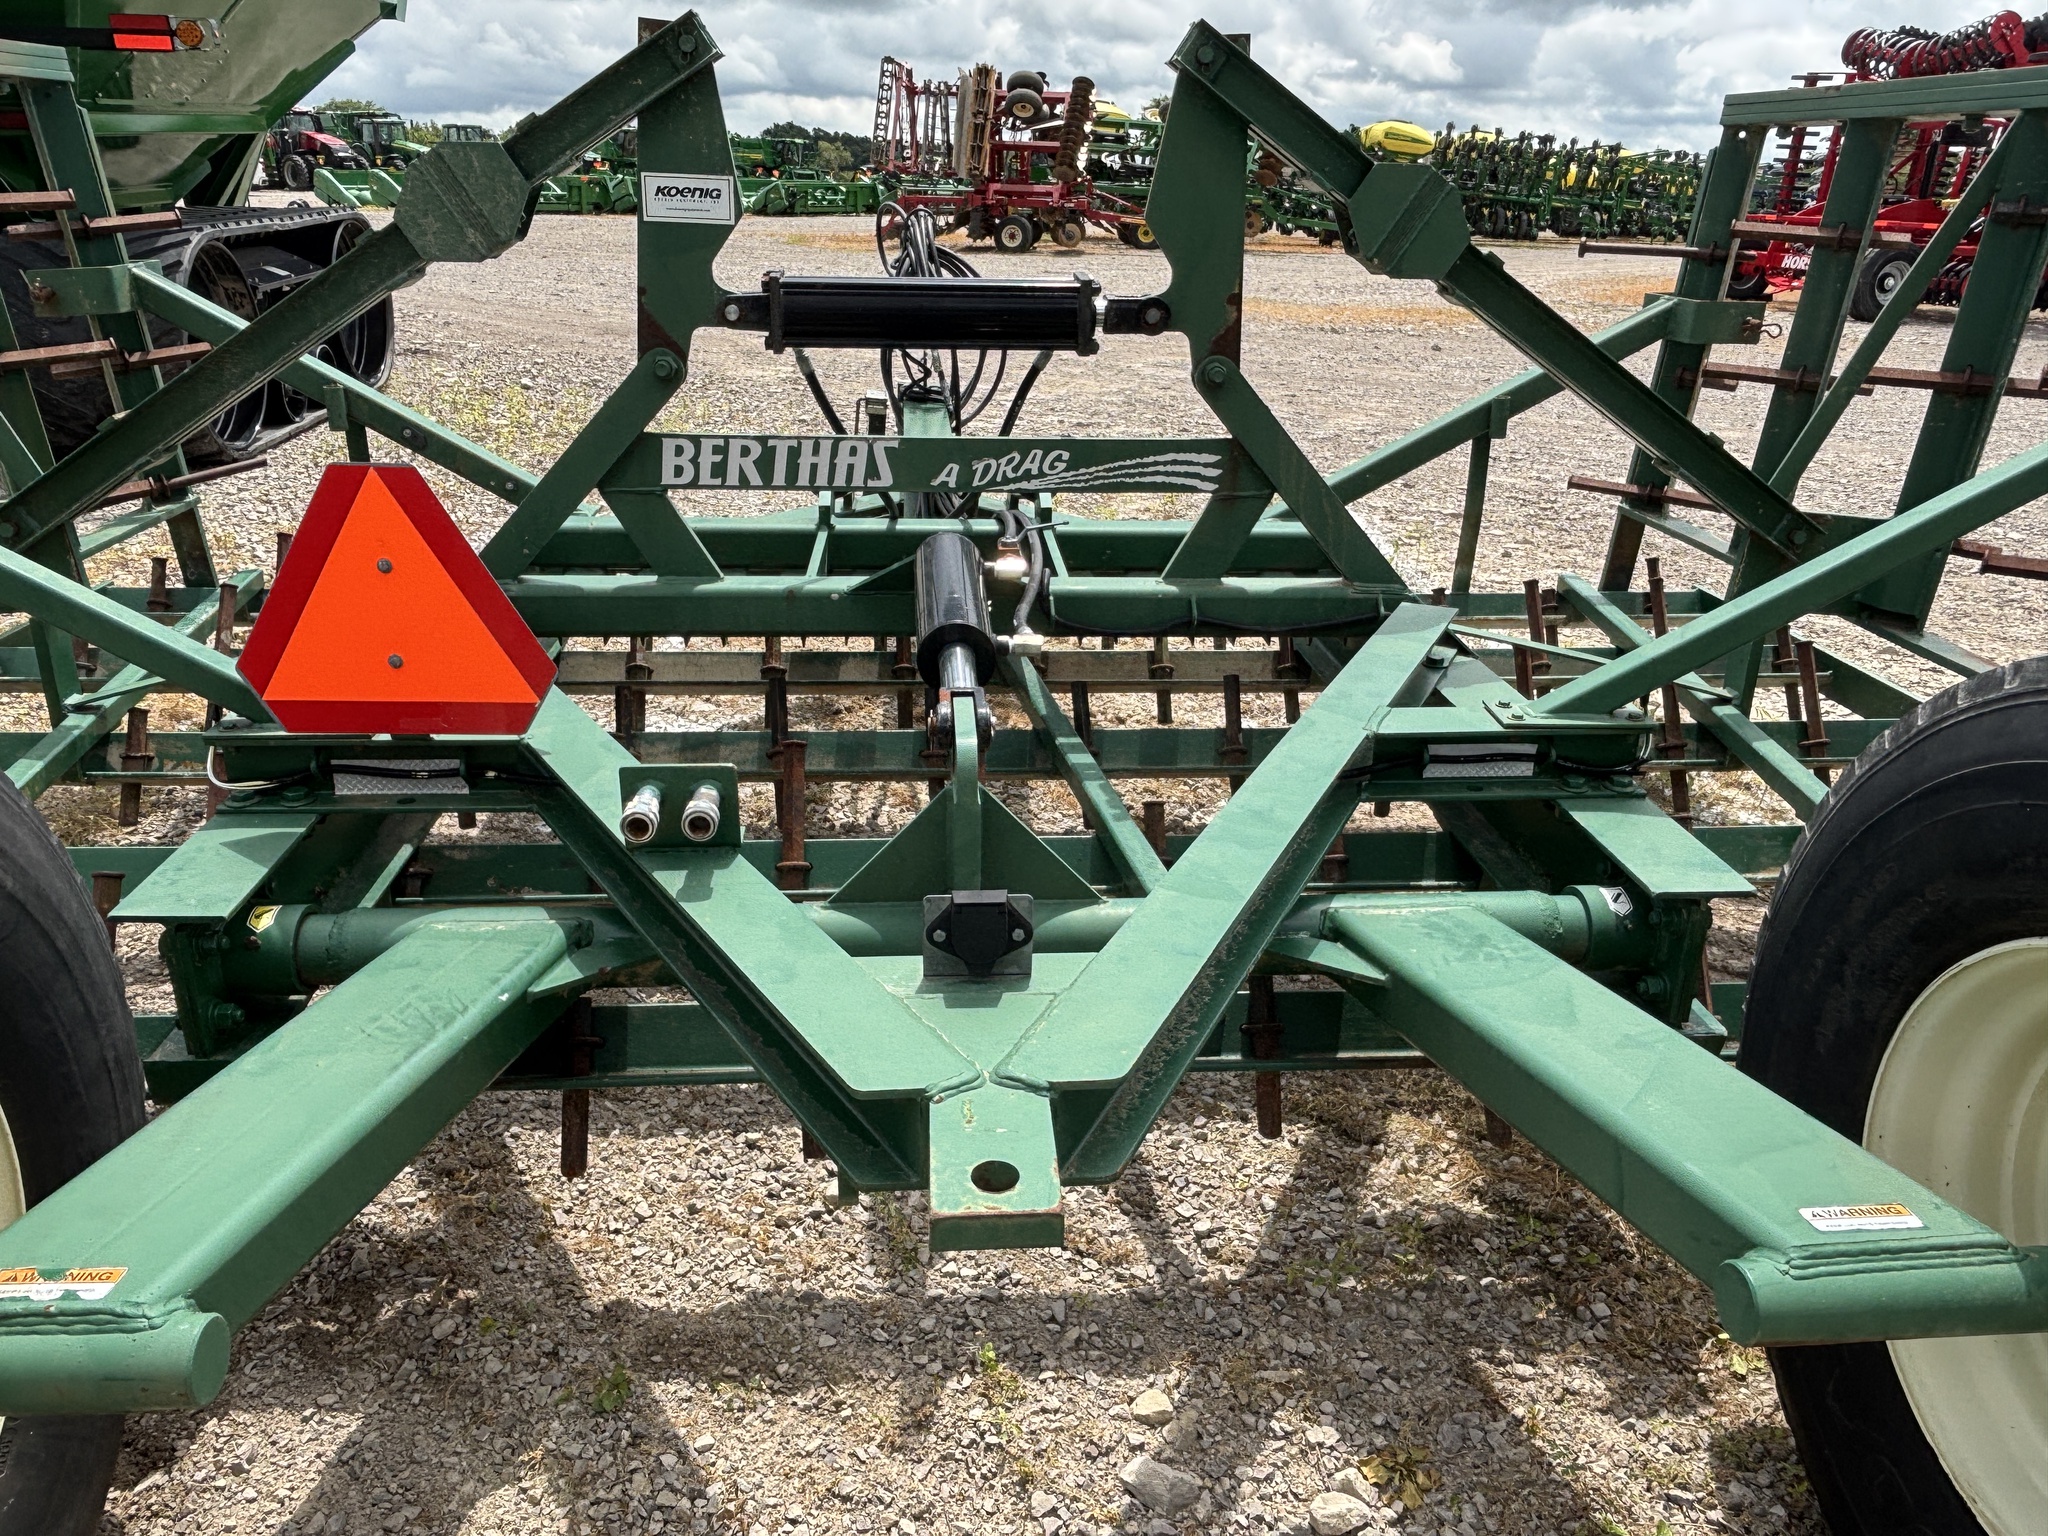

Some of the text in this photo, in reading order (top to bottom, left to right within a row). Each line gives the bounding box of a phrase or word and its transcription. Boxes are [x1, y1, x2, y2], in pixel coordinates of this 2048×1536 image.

[660, 437, 899, 488] BERTHAS
[930, 449, 1070, 488] A DRAG
[1822, 1206, 1903, 1218] WARNING
[21, 1271, 114, 1282] WNING
